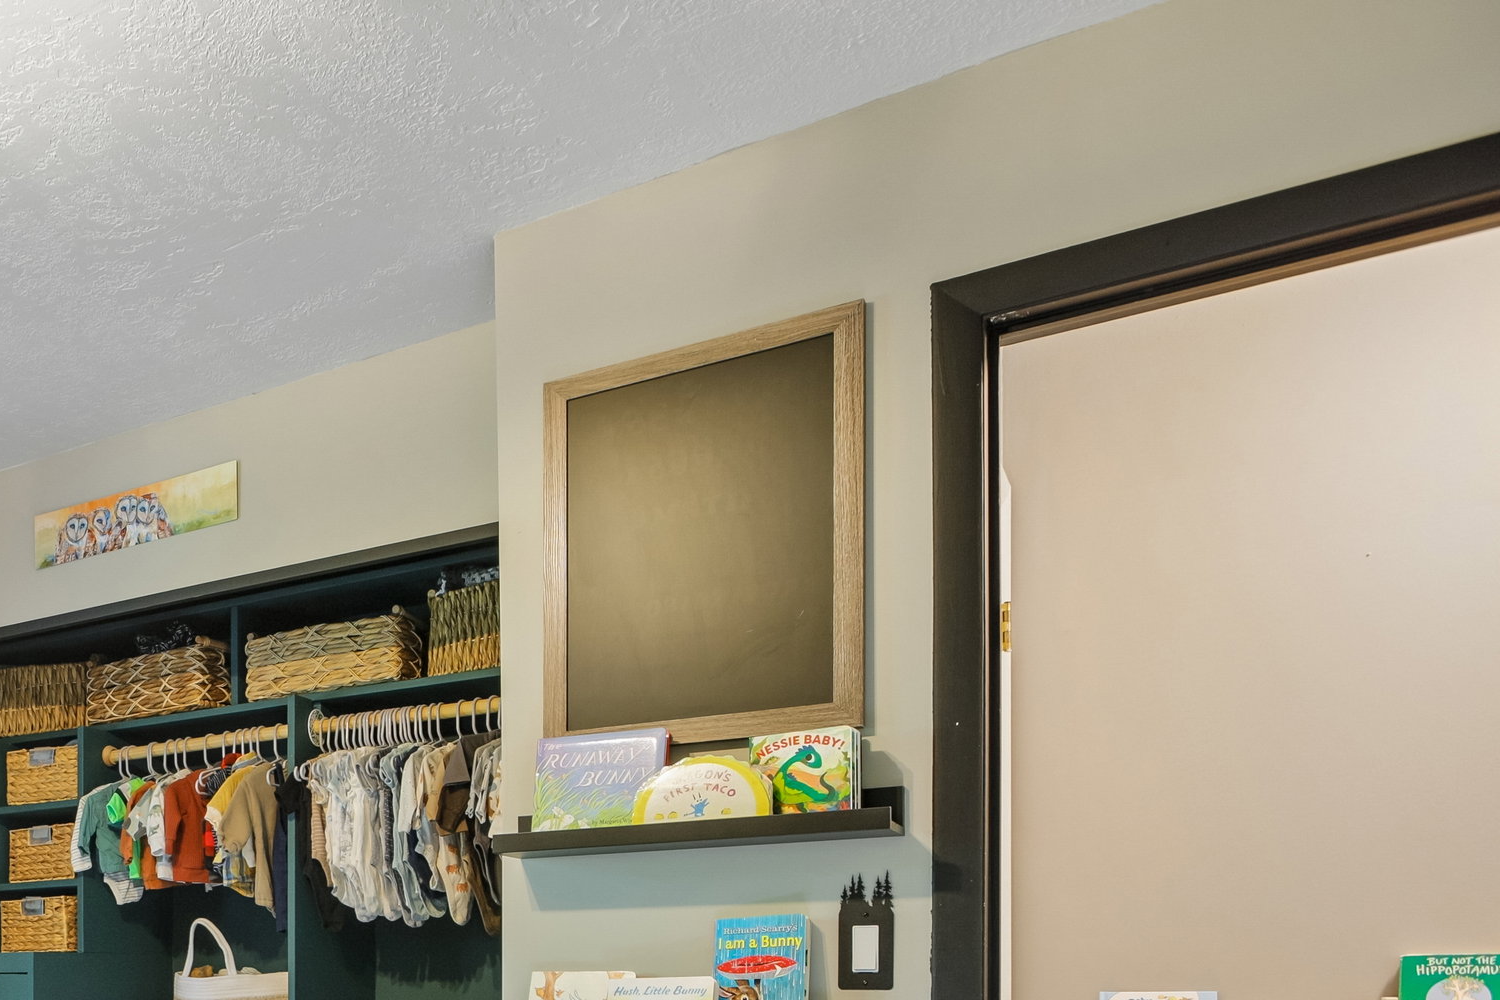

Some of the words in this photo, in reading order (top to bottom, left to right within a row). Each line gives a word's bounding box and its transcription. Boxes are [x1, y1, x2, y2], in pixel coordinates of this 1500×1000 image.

[756, 736, 800, 760] NESSIE
[804, 735, 845, 750] BABY!
[543, 746, 650, 769] RUNAWAY
[577, 766, 655, 787] BUNNY
[664, 783, 697, 802] FIRST
[705, 783, 737, 797] TACO
[723, 926, 759, 935] Richard
[761, 924, 797, 933] Scarry's
[719, 938, 721, 949] I
[726, 939, 745, 949] am
[749, 939, 757, 948] a
[762, 936, 802, 950] Bunny
[1426, 957, 1448, 966] BUT
[1476, 956, 1497, 964] THE
[644, 986, 671, 996] Little
[673, 986, 707, 997] Bunny
